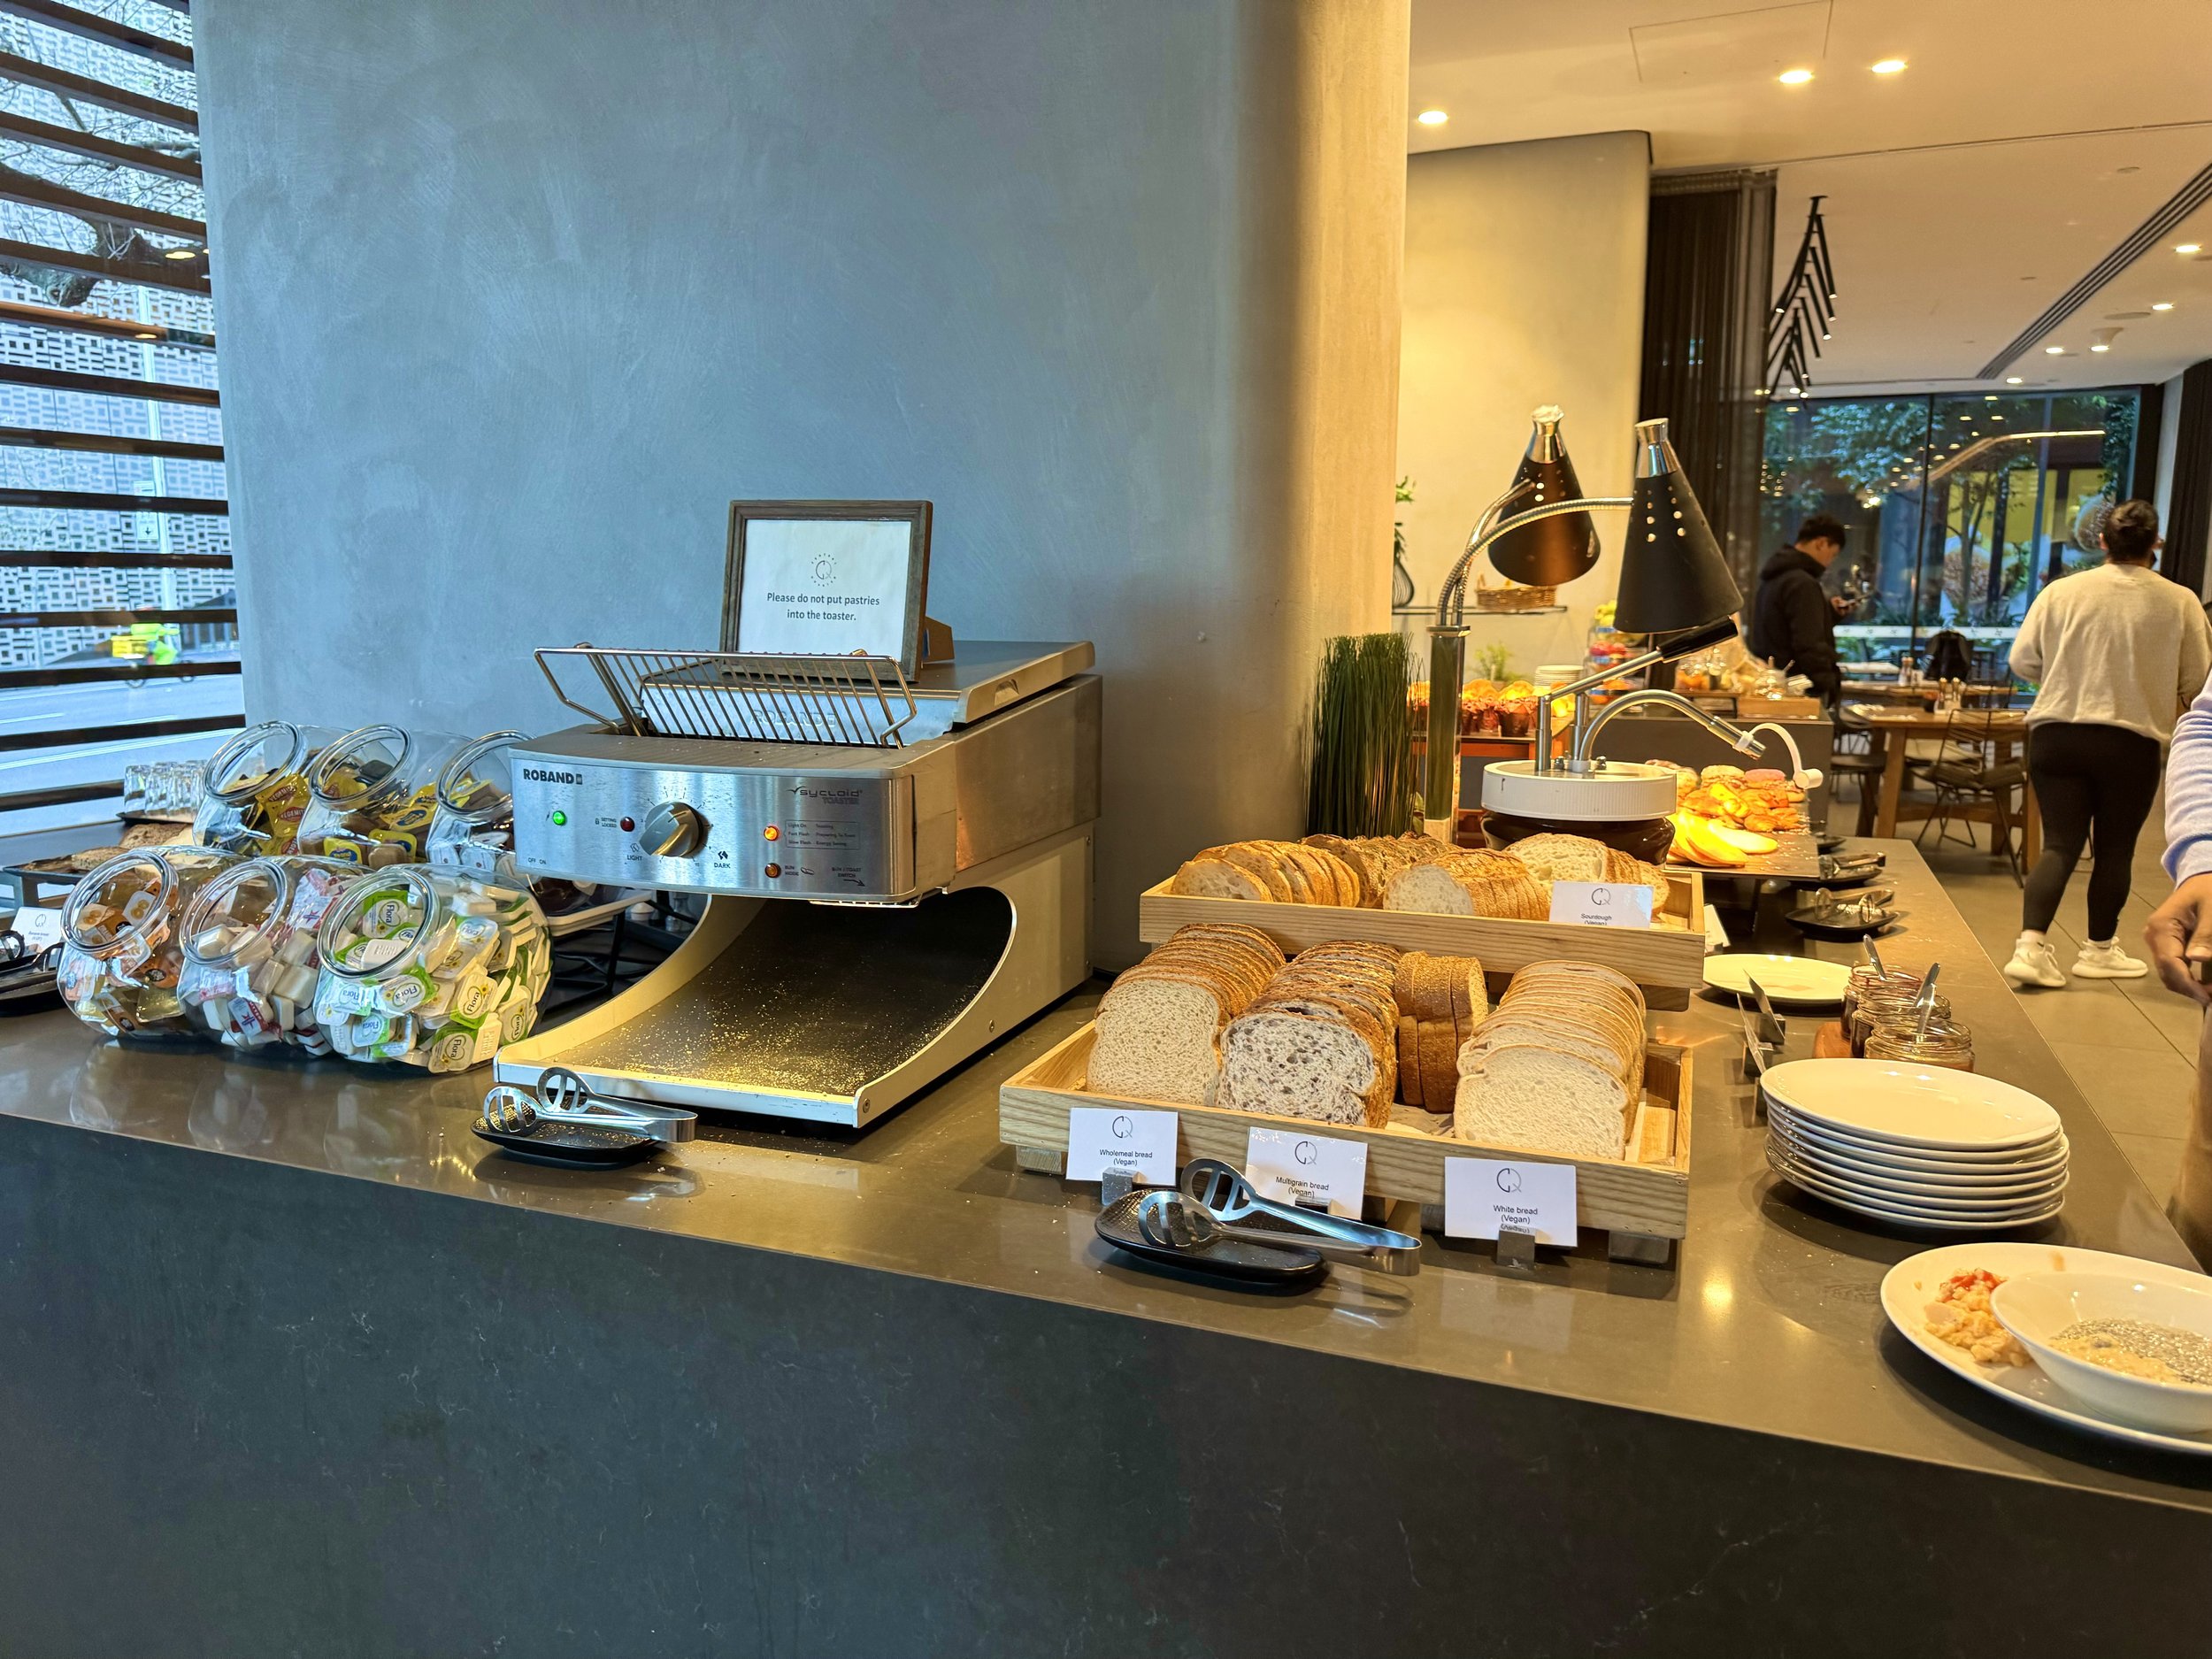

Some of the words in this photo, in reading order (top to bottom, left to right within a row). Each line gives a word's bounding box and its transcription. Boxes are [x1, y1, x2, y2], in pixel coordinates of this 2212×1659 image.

[767, 593, 795, 603] Please
[797, 594, 809, 603] do
[810, 595, 825, 603] not
[826, 595, 842, 605] put
[844, 595, 880, 606] pastries
[787, 609, 805, 619] into
[807, 610, 821, 619] the
[823, 611, 856, 621] toaster.
[524, 769, 575, 784] ROBAND
[385, 904, 395, 923] Flora
[395, 985, 418, 999] Flora
[467, 991, 480, 1012] Flora
[362, 1020, 379, 1029] Flora
[450, 1039, 462, 1058] Flora
[1099, 1148, 1133, 1157] Wholemeal
[1276, 1176, 1309, 1187] Multigrain
[1310, 1181, 1329, 1191] bread
[1288, 1187, 1315, 1199] (Vegan)
[1494, 1204, 1515, 1213] White
[1517, 1206, 1538, 1215] bread
[1501, 1214, 1531, 1224] (Vegan)
